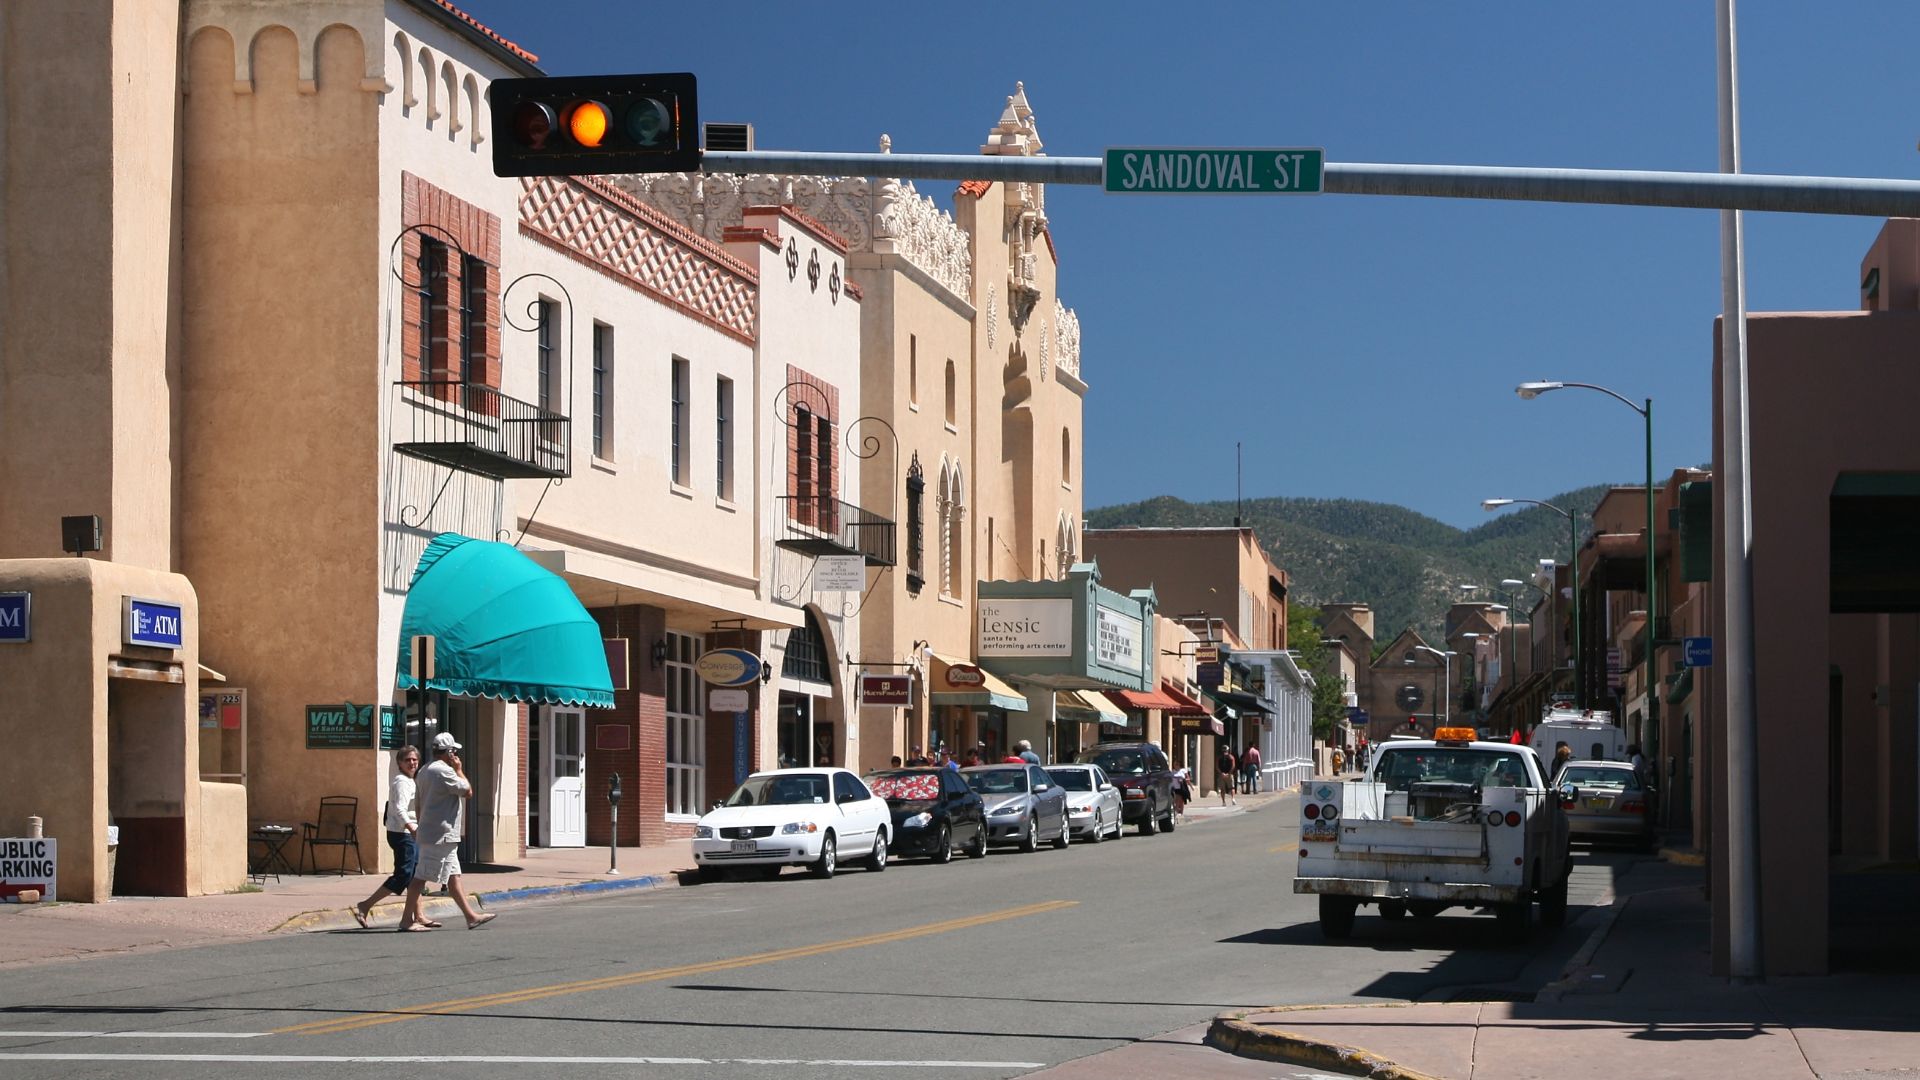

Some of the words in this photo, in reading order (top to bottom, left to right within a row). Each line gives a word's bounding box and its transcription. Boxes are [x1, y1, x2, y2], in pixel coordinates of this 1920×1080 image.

[1122, 153, 1260, 189] SANDOVAL
[1273, 154, 1305, 189] ST
[153, 615, 178, 636] ATM
[982, 618, 1040, 633] Lensic
[1690, 648, 1712, 656] PHONE
[223, 695, 240, 703] 225
[0, 860, 54, 878] RKING
